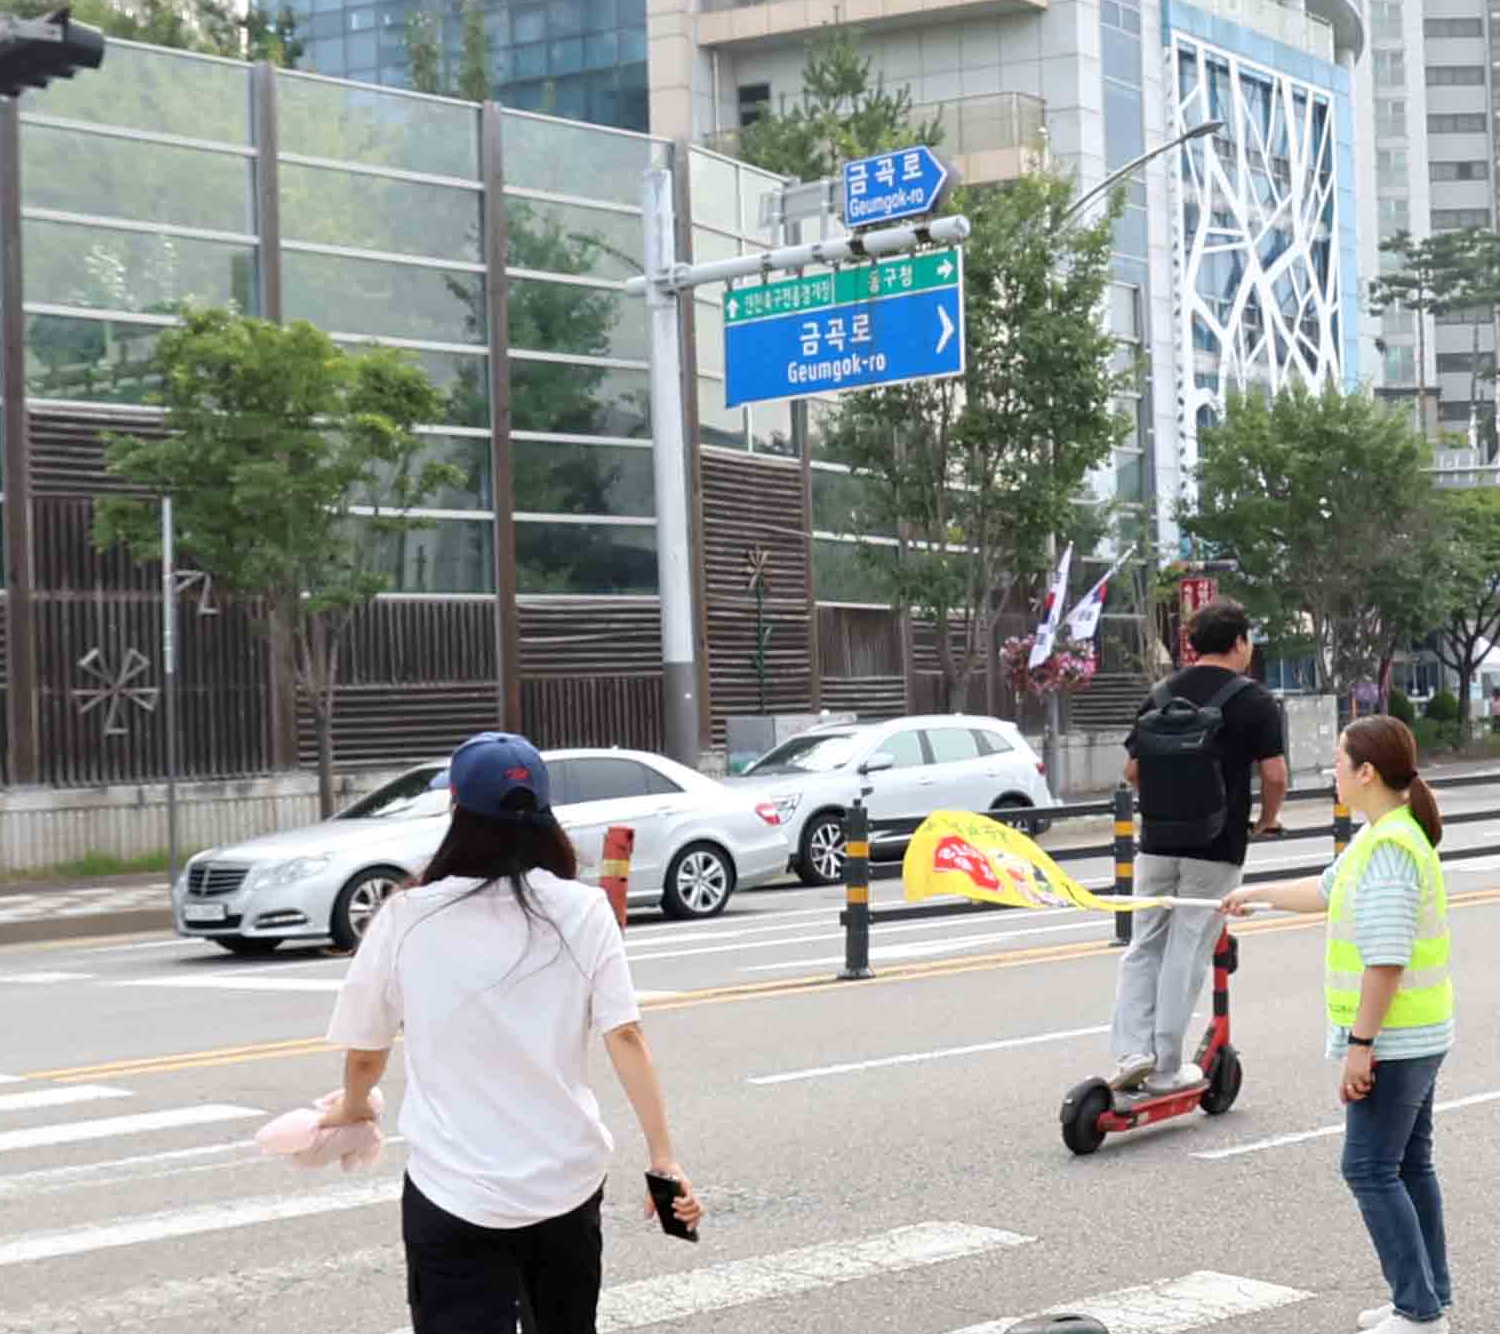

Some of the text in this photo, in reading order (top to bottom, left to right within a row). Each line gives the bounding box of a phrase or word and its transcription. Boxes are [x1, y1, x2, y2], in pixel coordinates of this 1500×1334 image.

[848, 153, 924, 196] 금곡로
[850, 187, 925, 217] Geumgok-ro
[799, 314, 872, 356] 금곡로
[787, 351, 887, 384] Geumgok-ro
